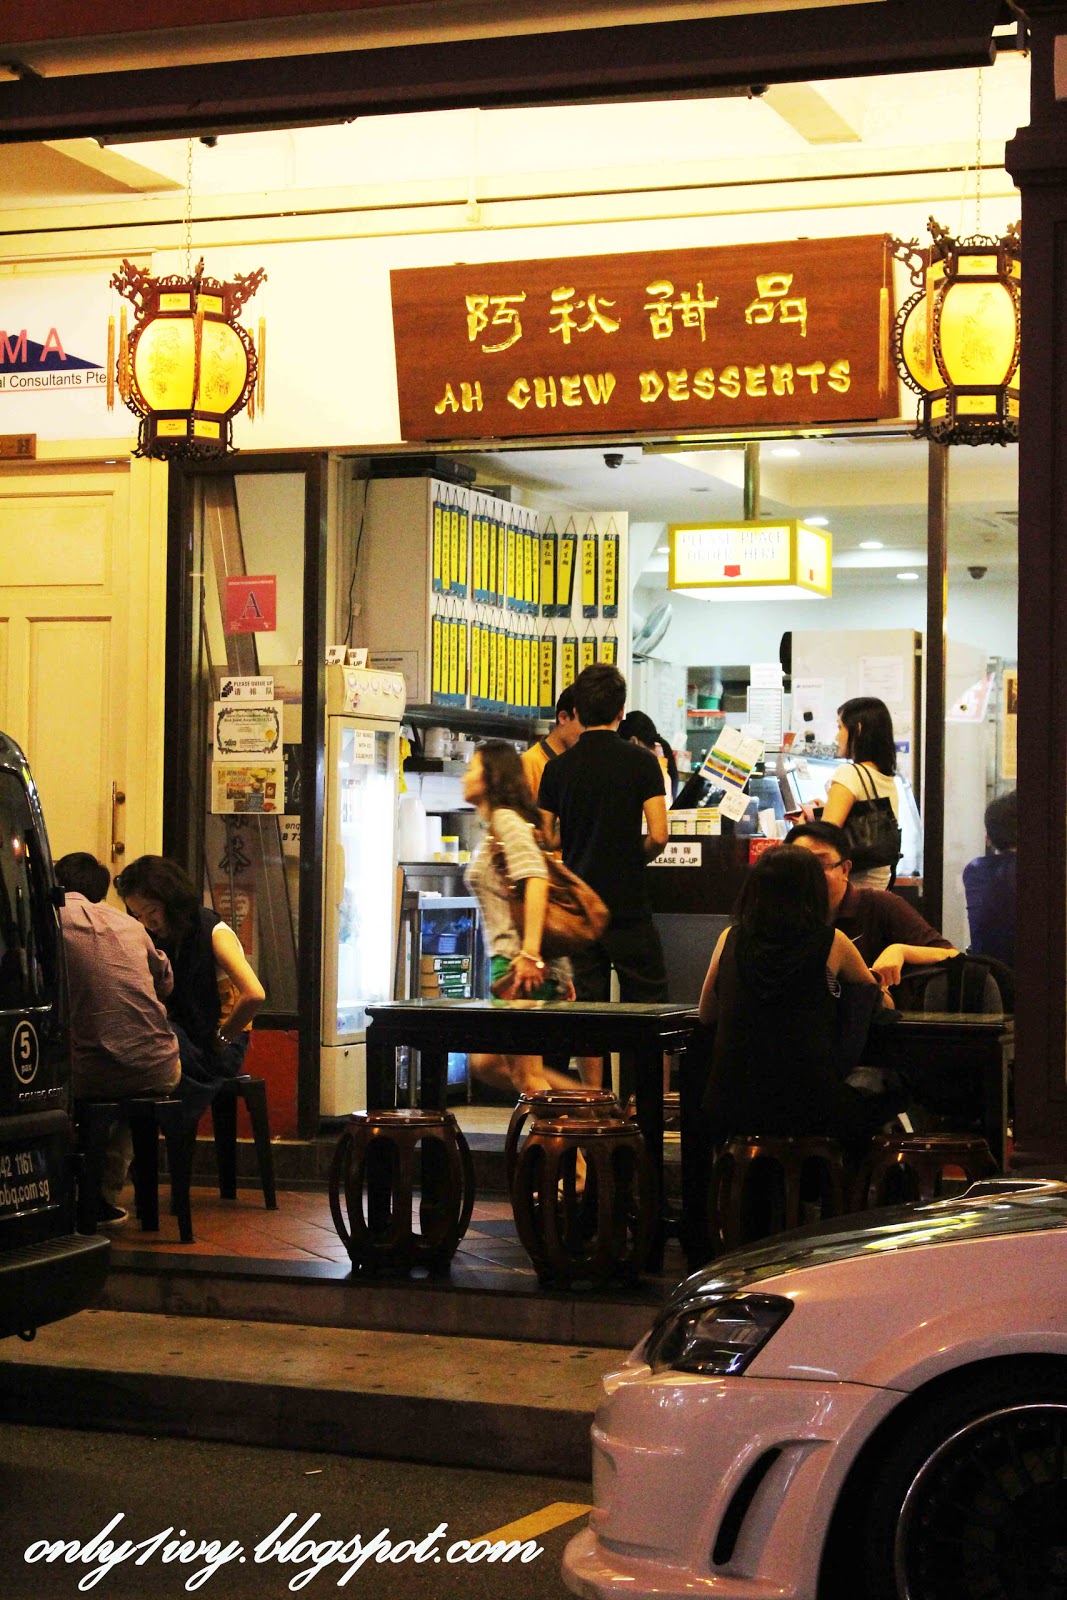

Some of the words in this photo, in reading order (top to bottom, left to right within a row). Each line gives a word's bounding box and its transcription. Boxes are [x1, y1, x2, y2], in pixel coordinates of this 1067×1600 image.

[465, 271, 808, 353] 阿秋甜品
[10, 373, 82, 388] Consultants
[86, 371, 107, 384] Pte
[435, 382, 483, 414] AH
[507, 372, 616, 410] CHEW
[639, 359, 851, 402] DESSERTS
[744, 547, 778, 560] HERE
[240, 591, 264, 619] A
[20, 1031, 31, 1059] 5
[15, 1151, 33, 1175] 1161
